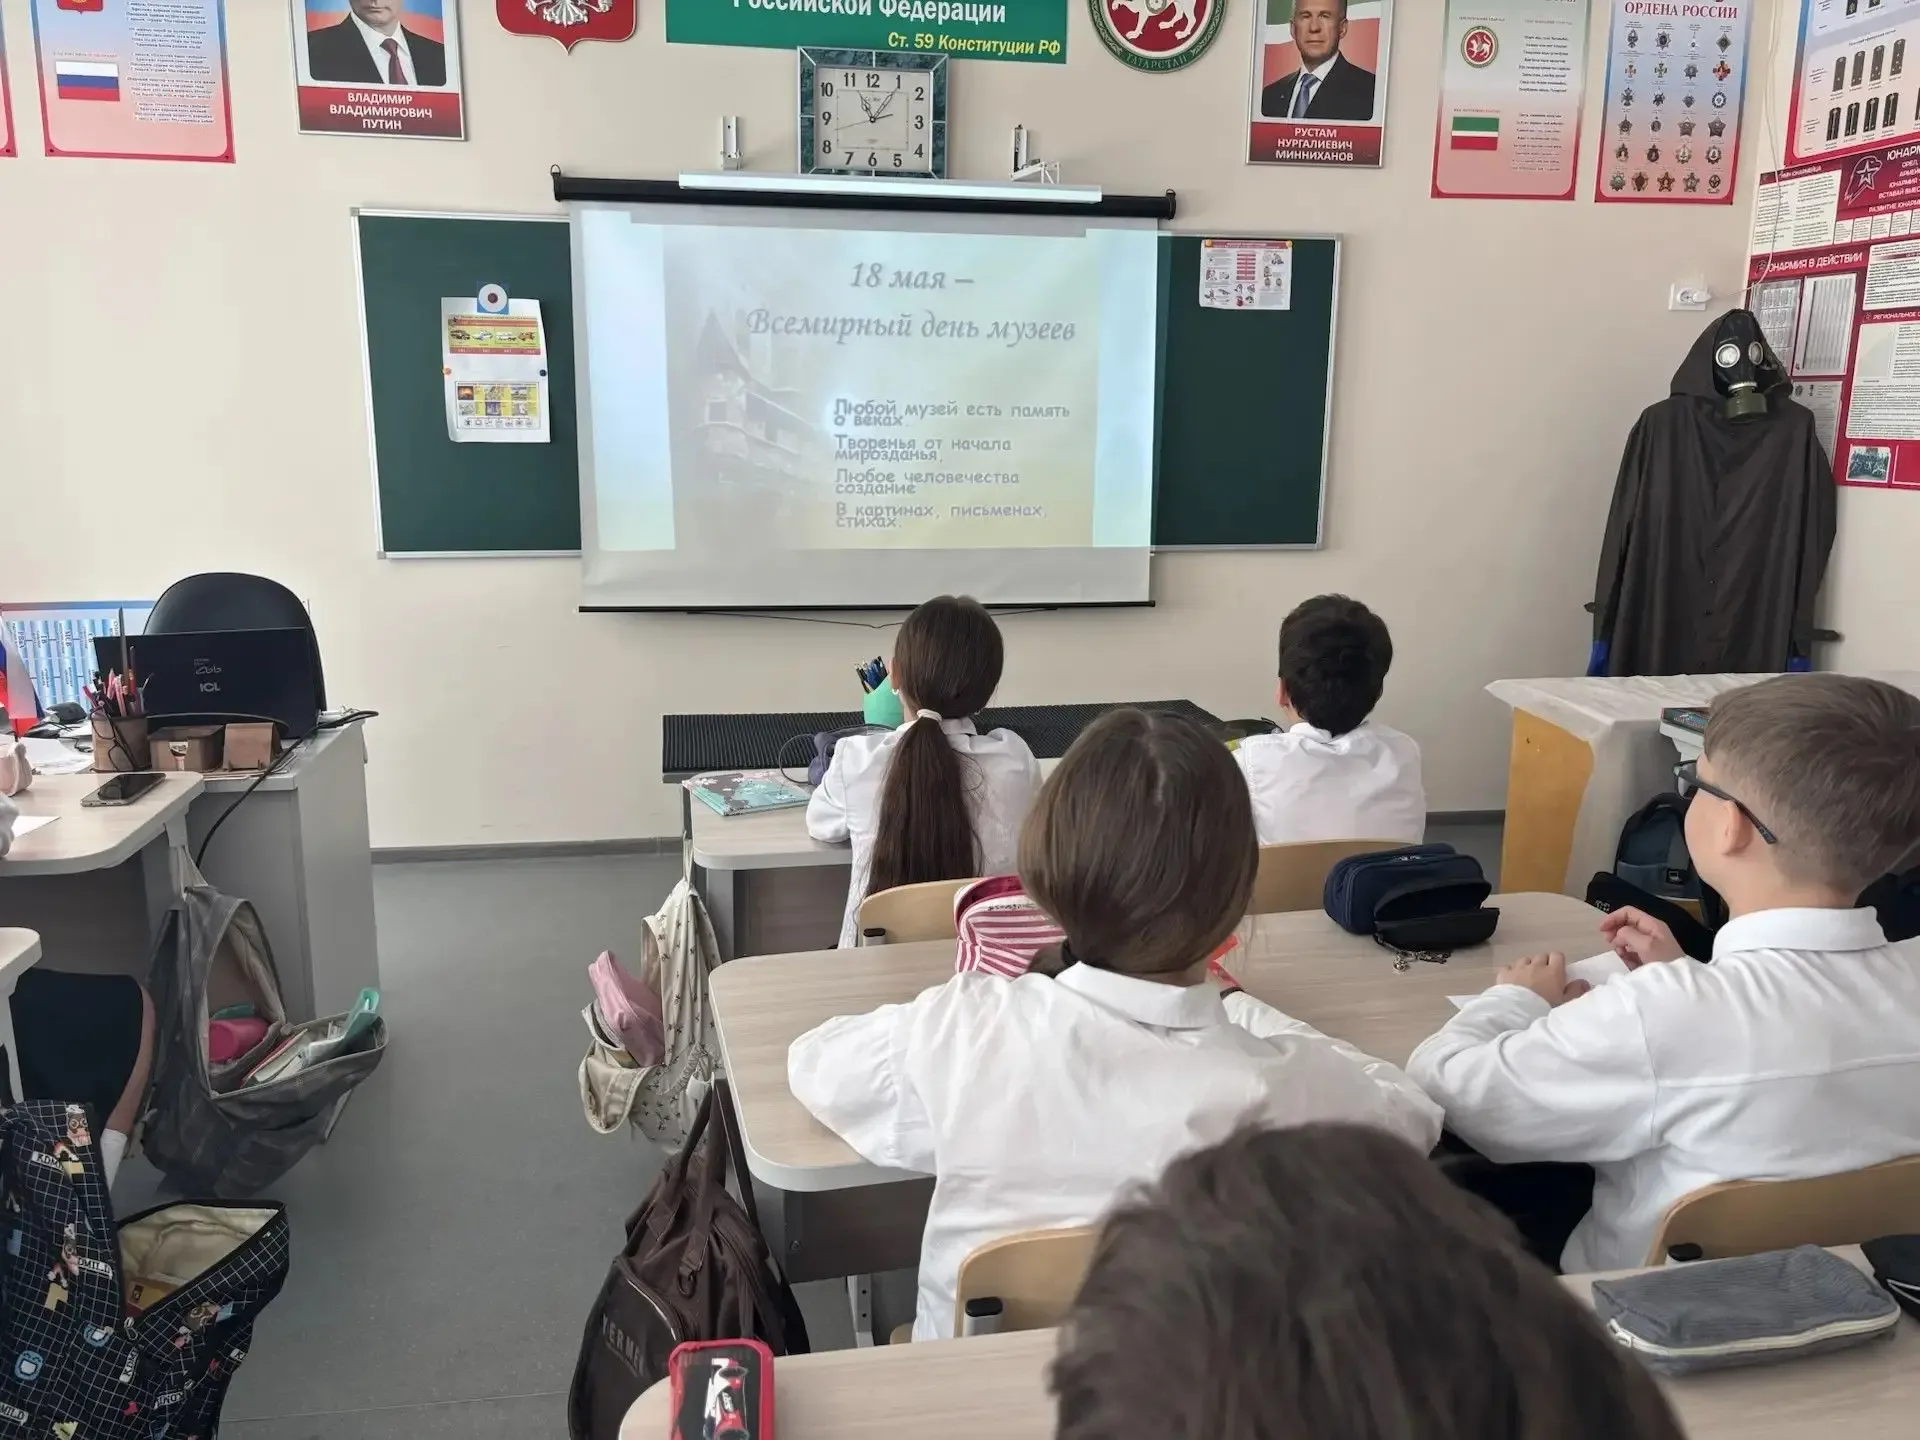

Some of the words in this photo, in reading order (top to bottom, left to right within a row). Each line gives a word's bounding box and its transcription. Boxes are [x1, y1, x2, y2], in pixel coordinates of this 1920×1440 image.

[879, 0, 1006, 25] Федерации
[1625, 2, 1678, 16] ОРДЕНА
[1682, 5, 1738, 18] РОССИИ
[888, 32, 909, 48] Ст.
[914, 33, 934, 49] 59
[938, 35, 1034, 56] Конституции
[1038, 40, 1061, 56] РФ
[1126, 53, 1188, 69] ТАТАРСТАН
[844, 72, 856, 87] 11
[866, 73, 880, 88] 12
[896, 74, 901, 89] 1
[820, 82, 833, 97] 10
[915, 86, 924, 101] 2
[348, 92, 413, 105] ВЛАДИМИР
[330, 104, 433, 118] ВЛАДИМИРОВИЧ
[822, 111, 831, 125] 9
[362, 118, 402, 130] ПУТИН
[914, 115, 924, 129] 3
[1294, 127, 1337, 138] РУСТАМ
[822, 140, 831, 154] 8
[914, 143, 923, 158] 4
[1277, 138, 1353, 149] НУРГАЛИЕВИЧ
[845, 152, 854, 165] 7
[868, 152, 877, 167] 6
[893, 153, 902, 167] 5
[1275, 150, 1354, 161] МИННИХАНОВ
[1809, 258, 1815, 267] В
[1816, 252, 1863, 268] ДЕЙСТВИИ
[850, 262, 882, 288] 18
[889, 269, 945, 290] мая
[746, 308, 911, 345] Всемирный
[921, 310, 980, 338] день
[986, 319, 1076, 347] музеев
[834, 398, 896, 417] Любой
[905, 401, 958, 419] музей
[966, 404, 1002, 417] есть
[1011, 405, 1070, 418] память
[834, 415, 845, 426] о
[834, 434, 916, 452] Творенья
[924, 438, 943, 450] от
[952, 439, 1012, 451] начала
[835, 450, 943, 464] мирозданья,
[835, 467, 895, 484] Любое
[904, 471, 1019, 485] человечества
[835, 483, 916, 496] создание
[836, 502, 847, 517] В
[856, 505, 940, 519] картинах,
